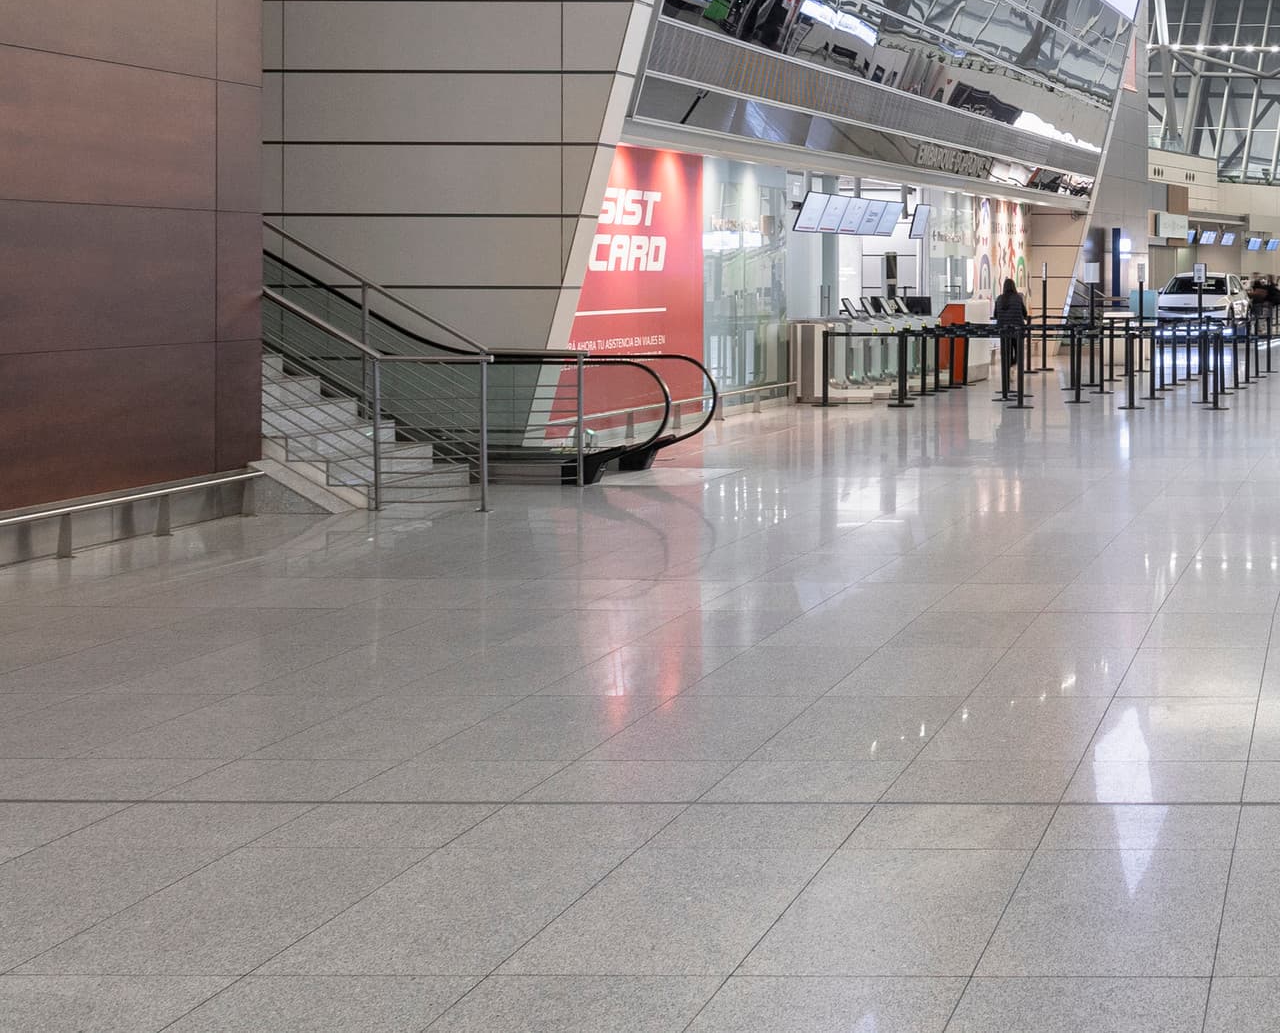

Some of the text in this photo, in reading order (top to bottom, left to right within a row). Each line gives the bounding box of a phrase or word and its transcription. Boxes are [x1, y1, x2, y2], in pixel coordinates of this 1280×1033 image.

[598, 187, 661, 226] SIST
[588, 234, 667, 272] CARD
[577, 341, 597, 351] AHORA
[597, 340, 606, 350] TU
[605, 338, 634, 349] ASISTENCIA
[634, 337, 641, 346] EN
[643, 335, 657, 345] VIAJES
[659, 335, 666, 344] EN
